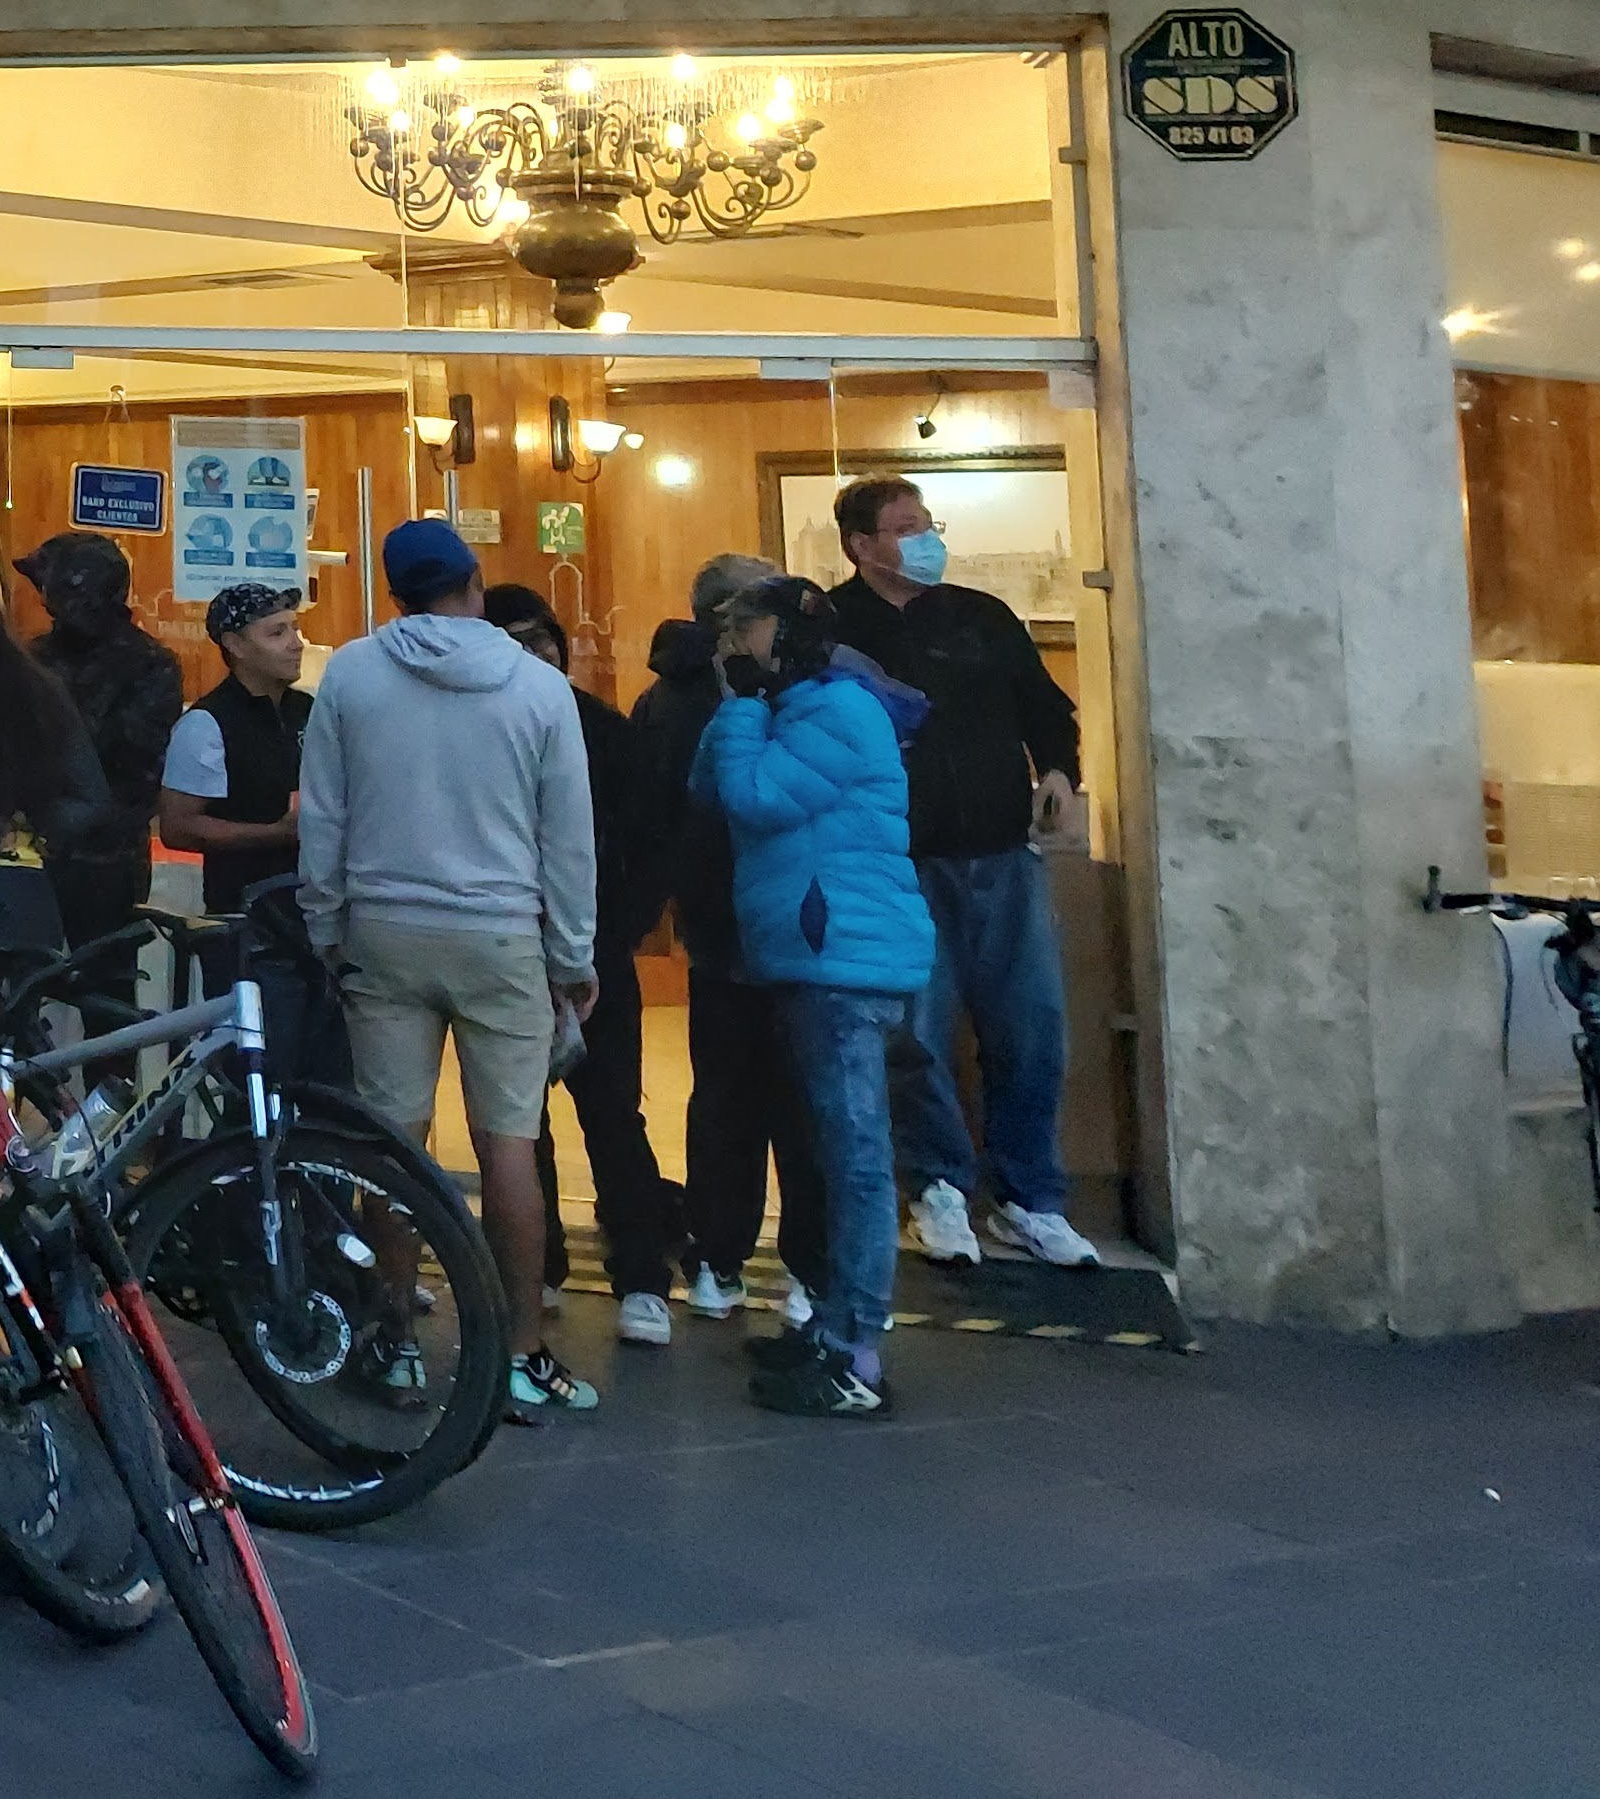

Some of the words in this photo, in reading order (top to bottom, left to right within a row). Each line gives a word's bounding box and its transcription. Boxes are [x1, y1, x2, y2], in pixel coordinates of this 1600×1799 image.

[1168, 20, 1244, 58] ALTO
[1143, 75, 1279, 115] SDS
[1208, 126, 1227, 145] 41
[107, 497, 155, 512] EXCLUSIVO
